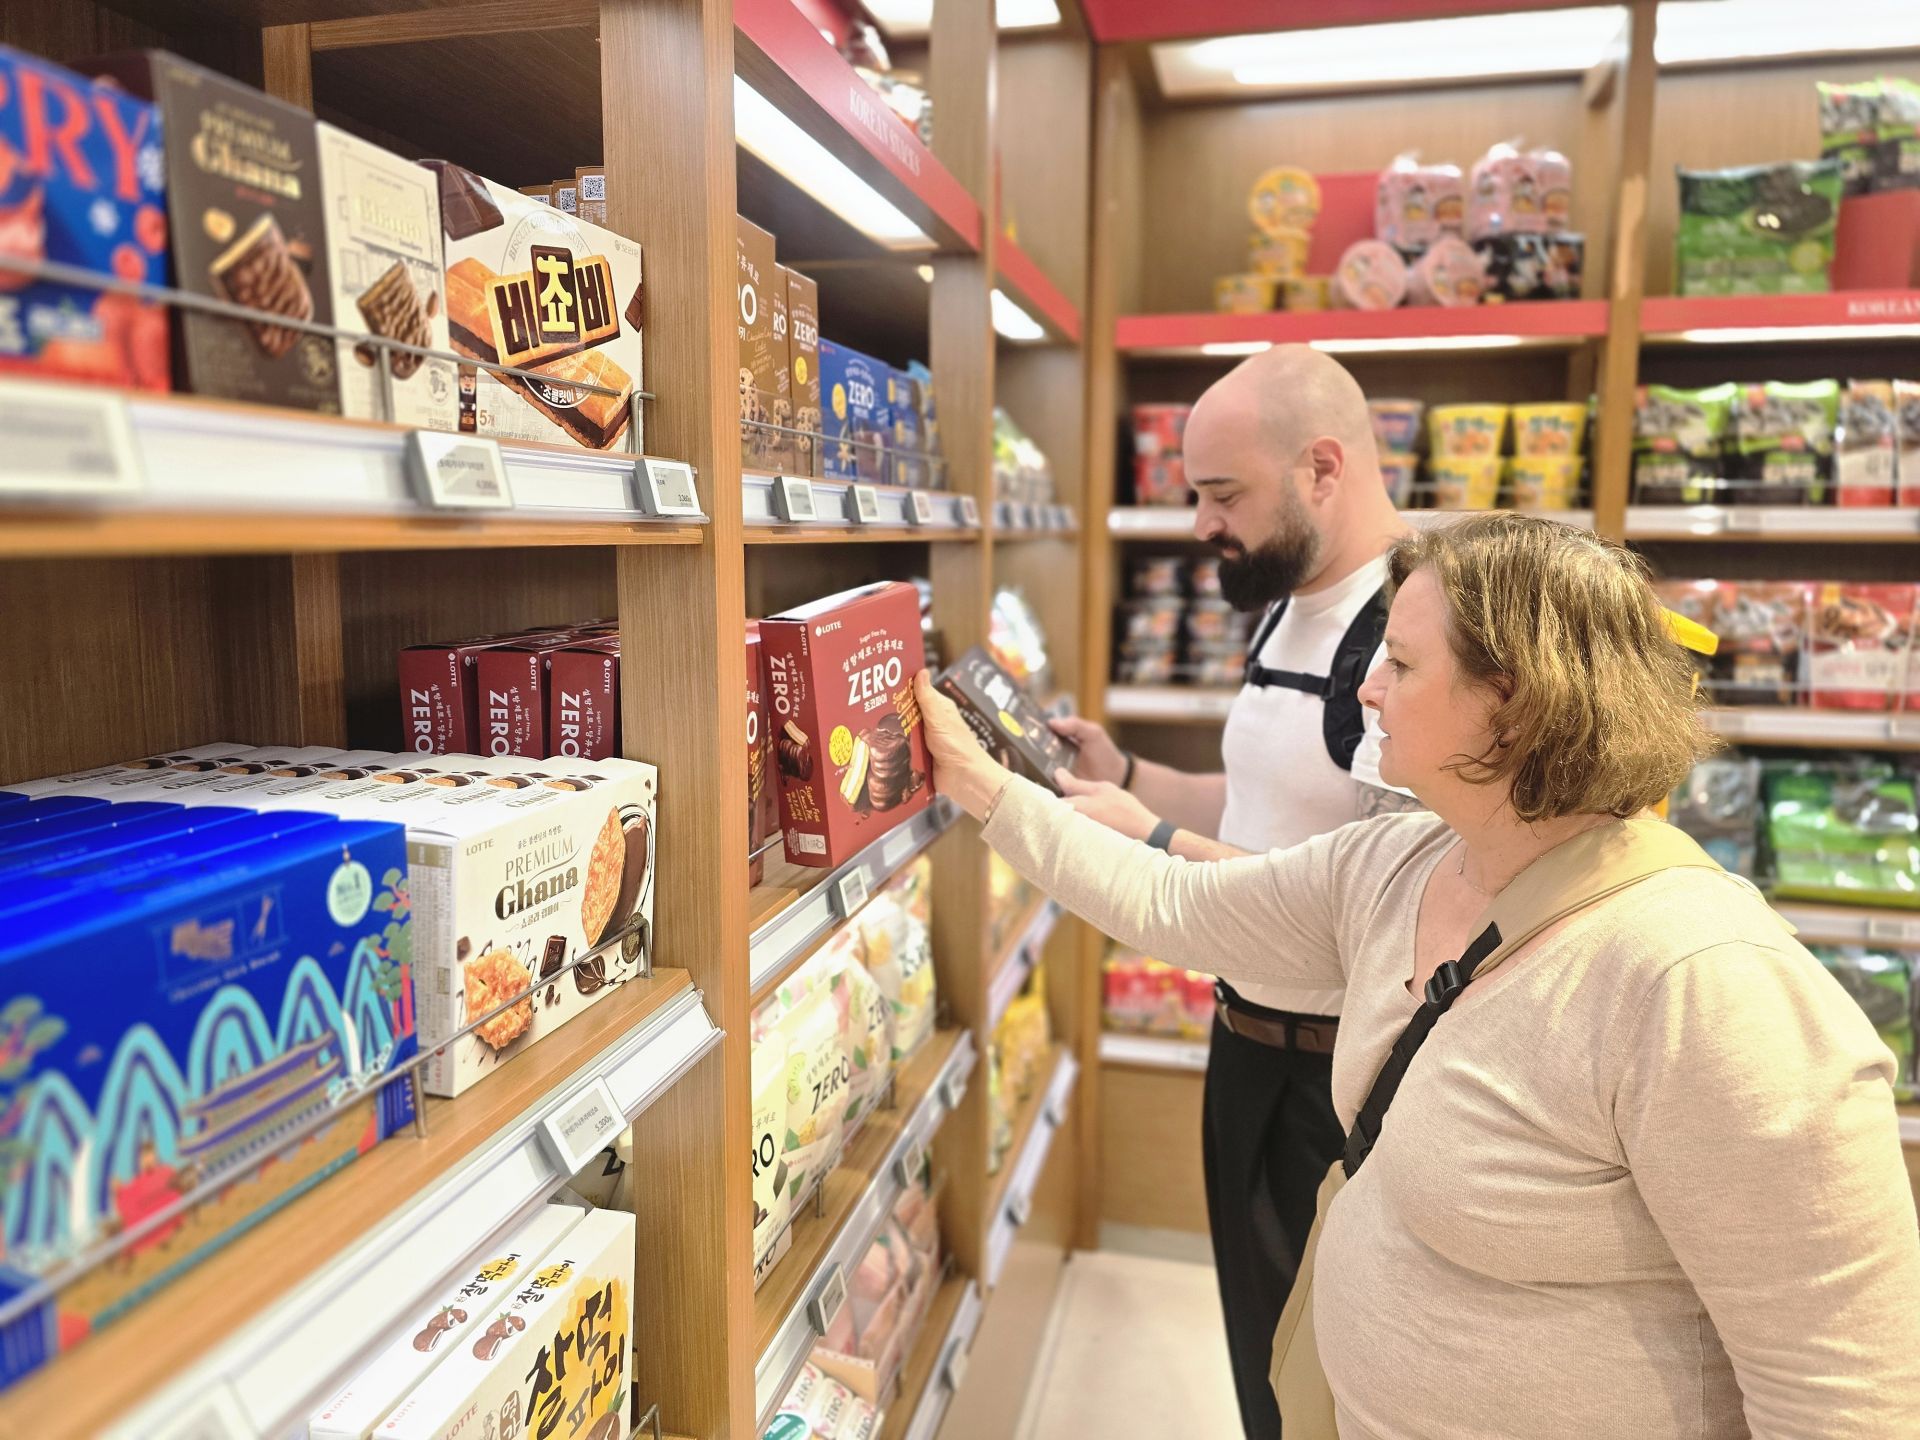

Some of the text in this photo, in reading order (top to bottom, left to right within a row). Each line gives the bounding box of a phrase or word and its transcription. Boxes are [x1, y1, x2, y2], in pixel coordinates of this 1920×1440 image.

[0, 68, 151, 202] RY
[850, 86, 888, 146] KOREAN
[494, 254, 612, 356] 비쵸비
[737, 282, 757, 326] O
[794, 319, 818, 347] ZERO
[848, 380, 874, 410] ZERO
[822, 621, 842, 634] LOTTE
[770, 655, 791, 715] ZERO
[848, 656, 902, 706] ZERO
[411, 688, 434, 754] ZERO
[489, 690, 510, 757] ZERO
[510, 686, 522, 756] 설탕제로·당류제
[561, 691, 580, 758] ZERO
[583, 688, 594, 758] 설탕제로·당류제
[466, 838, 494, 856] LOTTE
[505, 835, 573, 881] PREMIUM
[495, 866, 579, 921] Ghana
[811, 1055, 850, 1115] ZERO
[446, 1402, 479, 1440] LOTTE
